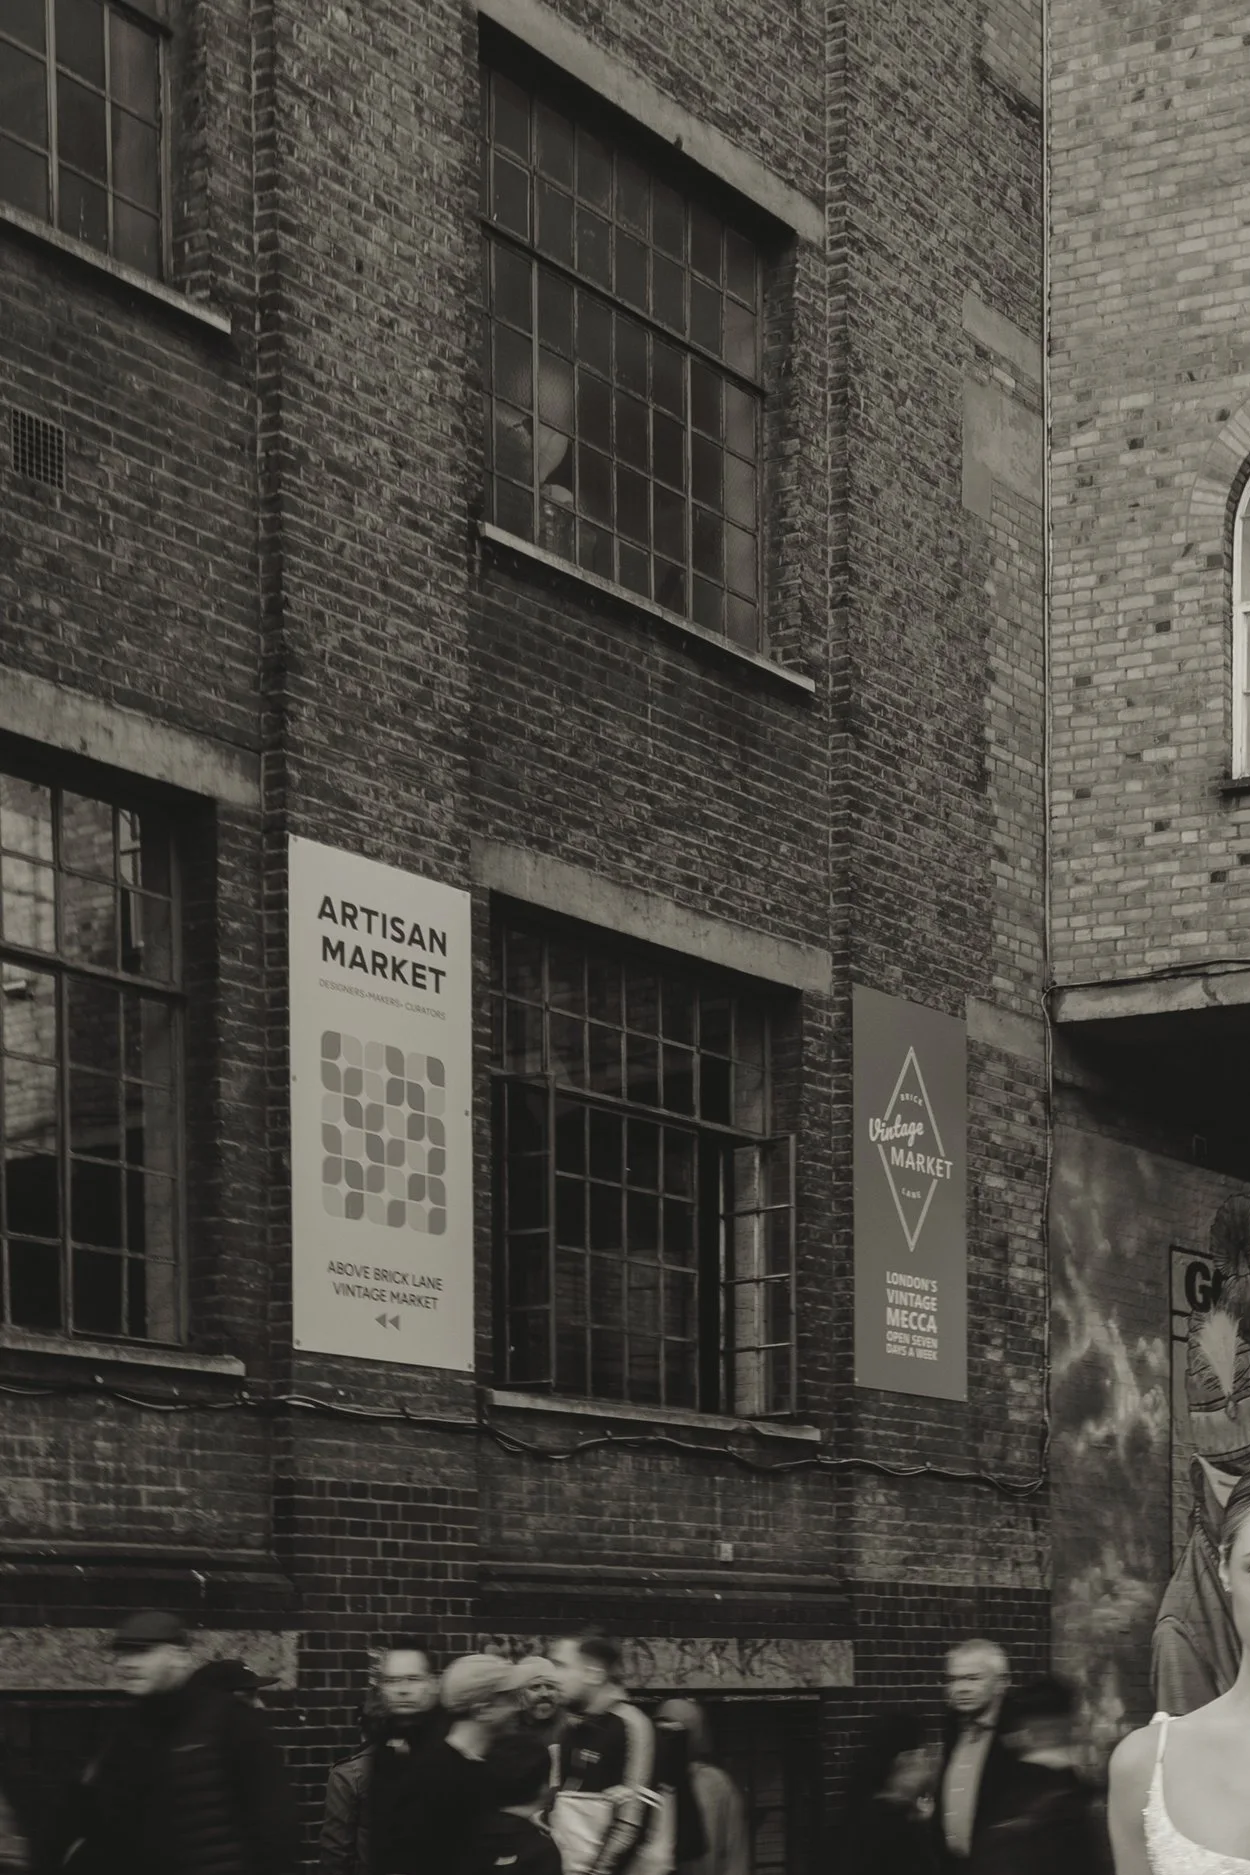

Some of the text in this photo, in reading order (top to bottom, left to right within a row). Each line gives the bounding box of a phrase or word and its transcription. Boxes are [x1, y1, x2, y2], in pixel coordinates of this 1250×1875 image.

[317, 895, 447, 957] ARTISAN
[322, 934, 447, 994] MARKET
[868, 1113, 925, 1148] Vintage
[890, 1145, 954, 1180] MARKET
[326, 1259, 444, 1292] ABOVE BRICK LANE
[885, 1270, 939, 1293] LONDON'S
[331, 1281, 440, 1311] VINTAGE MARKET
[885, 1287, 939, 1312] VINTAGE
[885, 1306, 939, 1334] MECCA
